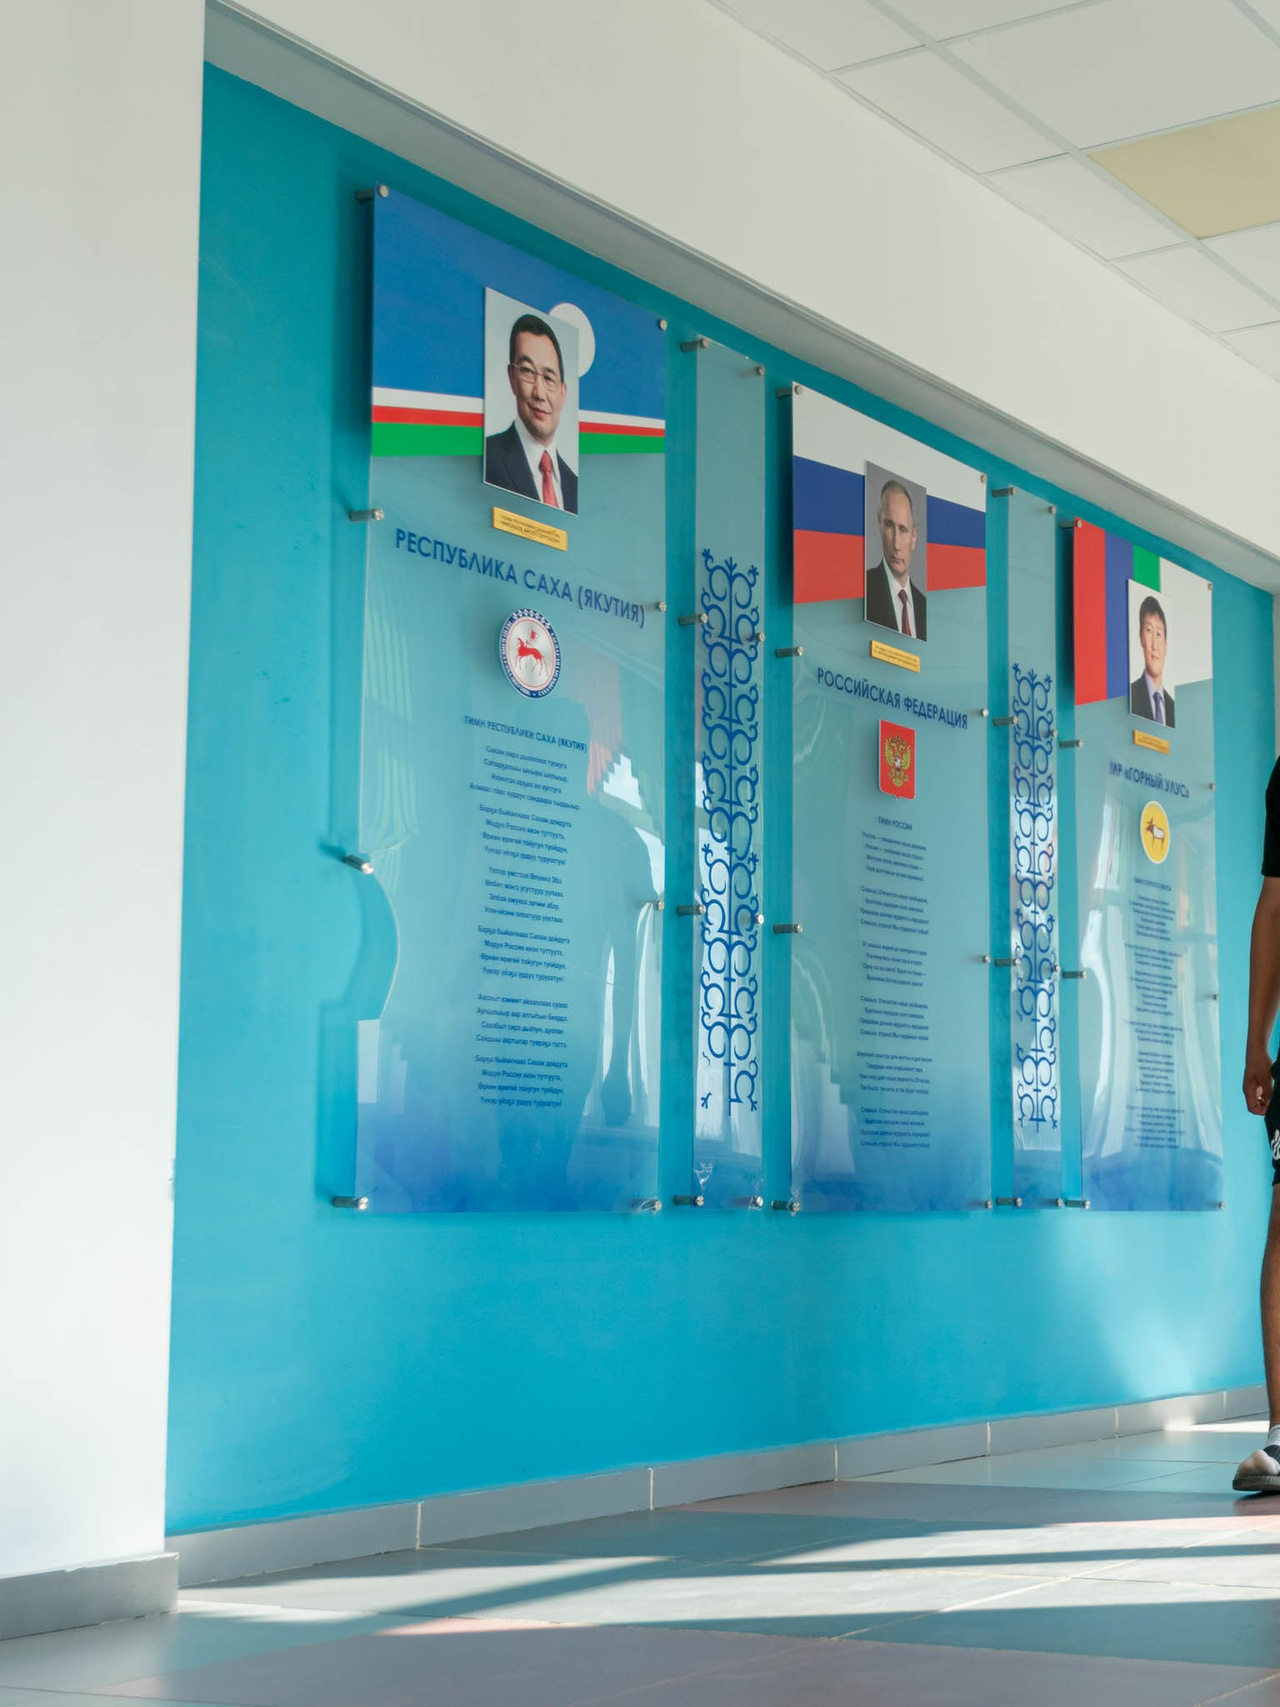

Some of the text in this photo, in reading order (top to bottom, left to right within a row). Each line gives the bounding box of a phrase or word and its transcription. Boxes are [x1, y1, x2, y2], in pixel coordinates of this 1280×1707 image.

[396, 528, 518, 584] РЕСПУБЛИКА
[524, 569, 573, 602] САХА
[578, 585, 645, 629] (ЯКУТИЯ)
[817, 667, 968, 730] РОССИЙСКАЯ ФЕДЕРАЦИЯ
[487, 720, 534, 739] РЕСПУБЛИКИ
[536, 732, 556, 744] САХА
[558, 737, 587, 754] (ЯКУТИЯ)
[1124, 765, 1163, 790] «ГОРНЫЙ
[1165, 778, 1190, 799] УЛУС»
